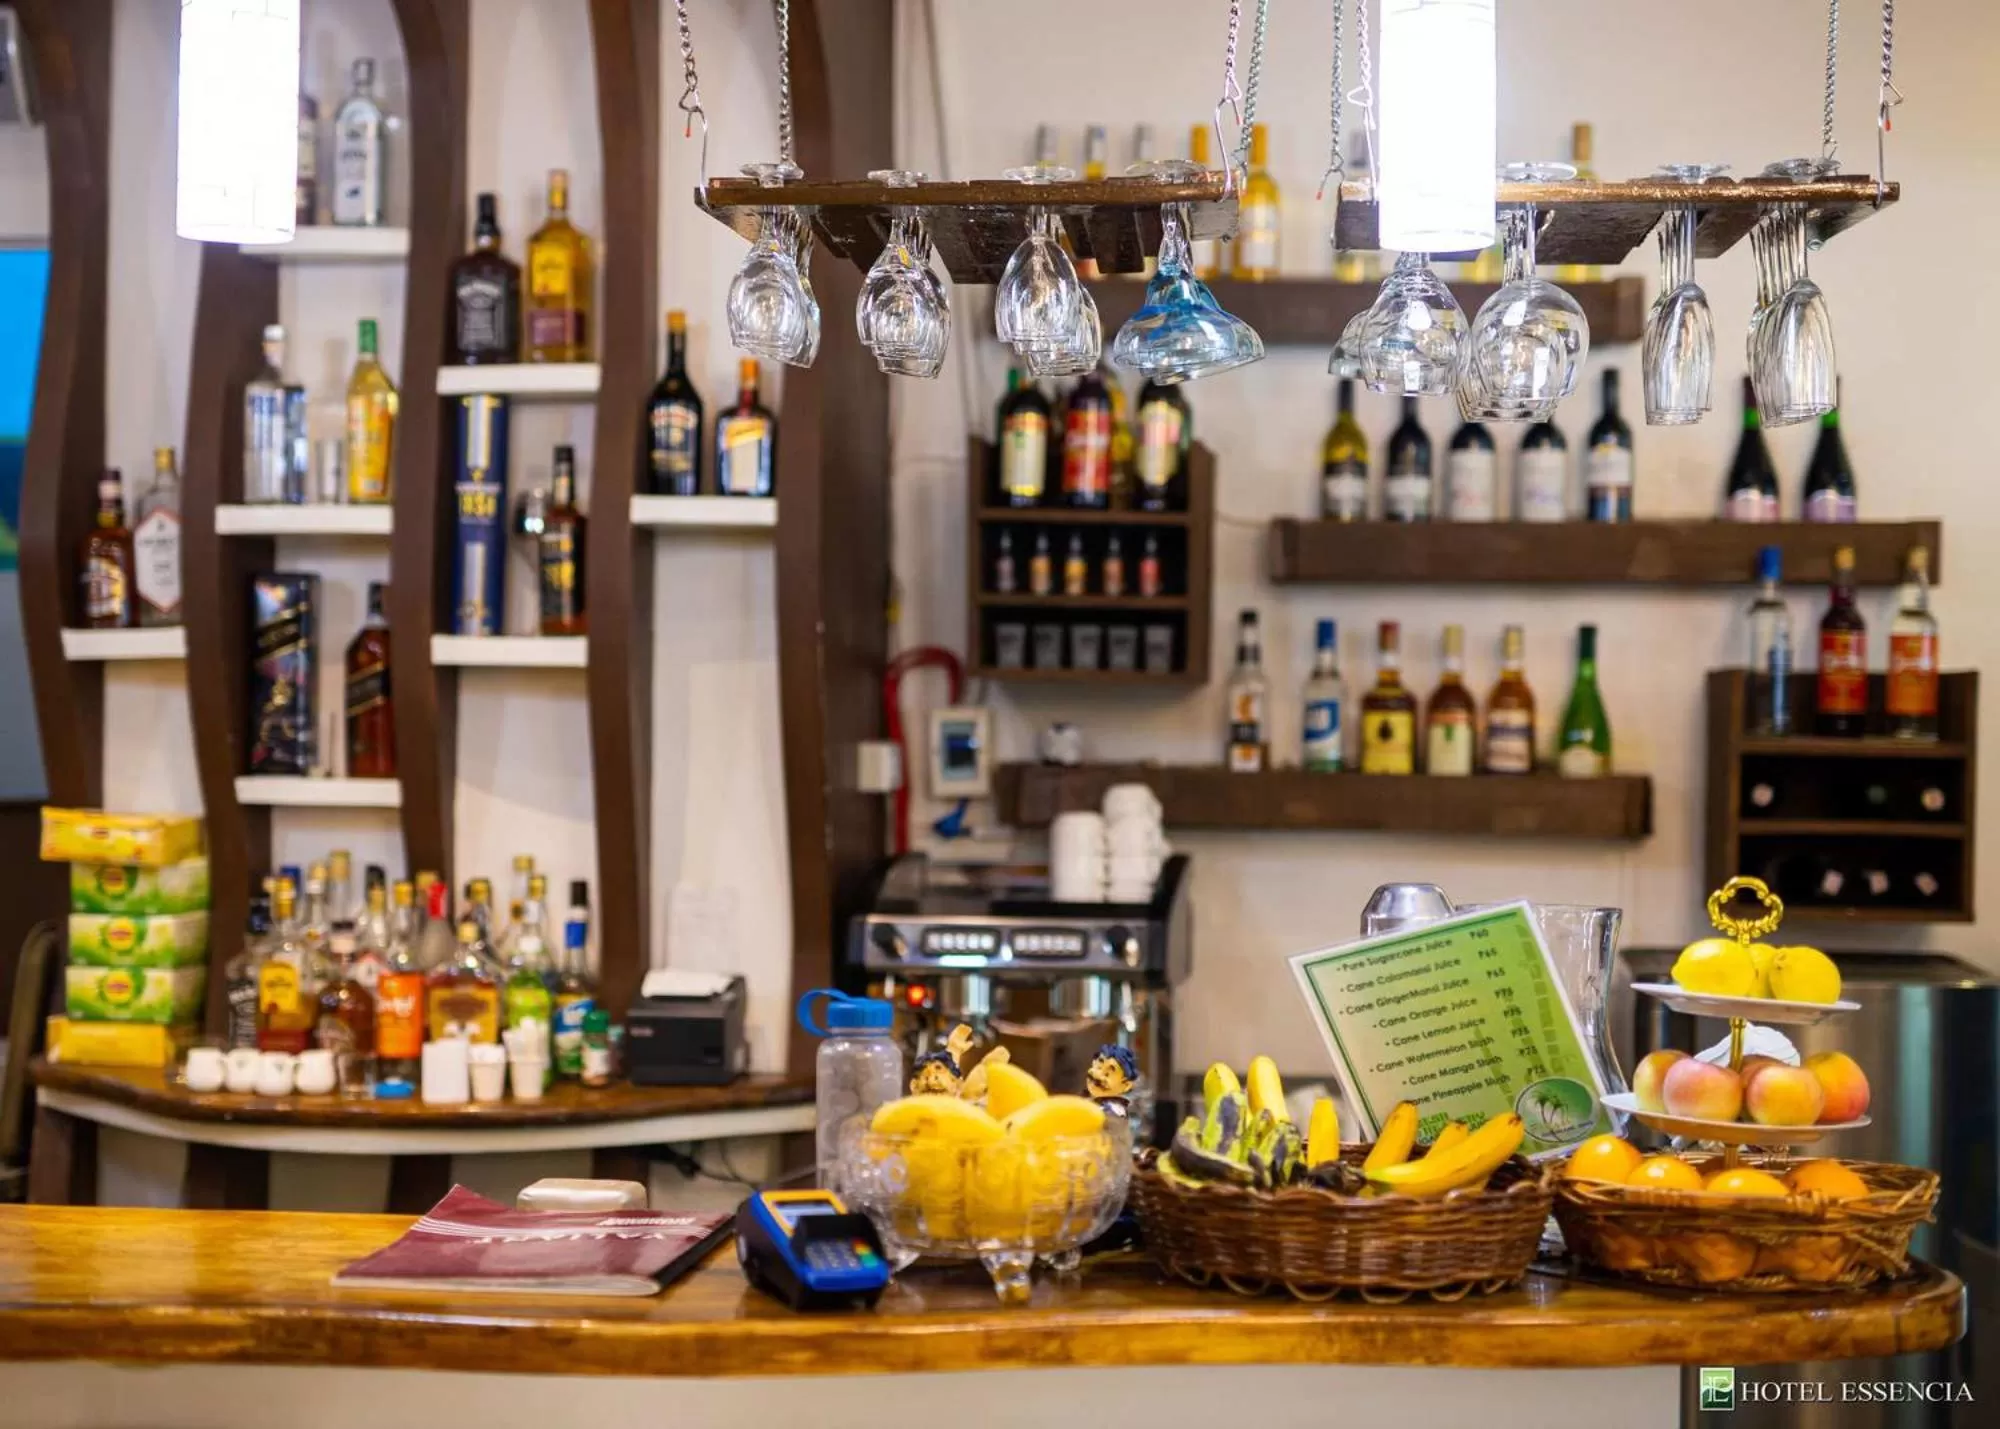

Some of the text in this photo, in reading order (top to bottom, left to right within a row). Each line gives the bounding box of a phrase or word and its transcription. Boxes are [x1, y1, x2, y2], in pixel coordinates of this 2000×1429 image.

[1342, 961, 1365, 970] Pure
[1426, 940, 1452, 951] Juice
[1346, 981, 1374, 992] Cane
[1376, 964, 1432, 984] Calamansi
[1434, 959, 1460, 970] Juice
[1346, 1003, 1374, 1015] Cane
[1443, 978, 1469, 990] Juice
[1378, 1016, 1407, 1028] Cane
[1409, 1006, 1448, 1020] Orange
[1451, 998, 1476, 1010] Juice
[1392, 1034, 1420, 1046] Cane
[1422, 1025, 1456, 1039] Lemon
[1460, 1018, 1485, 1030] Juice
[1376, 1060, 1404, 1072] Cane
[1406, 1044, 1467, 1064] Watermelon
[1468, 1036, 1494, 1048] Slush
[1409, 1073, 1436, 1085] Cane
[1439, 1063, 1475, 1076] Mango
[1476, 1055, 1502, 1068] Slush
[1409, 1096, 1430, 1106] ane
[1432, 1082, 1482, 1100] Pineapple
[1484, 1073, 1510, 1086] Slush
